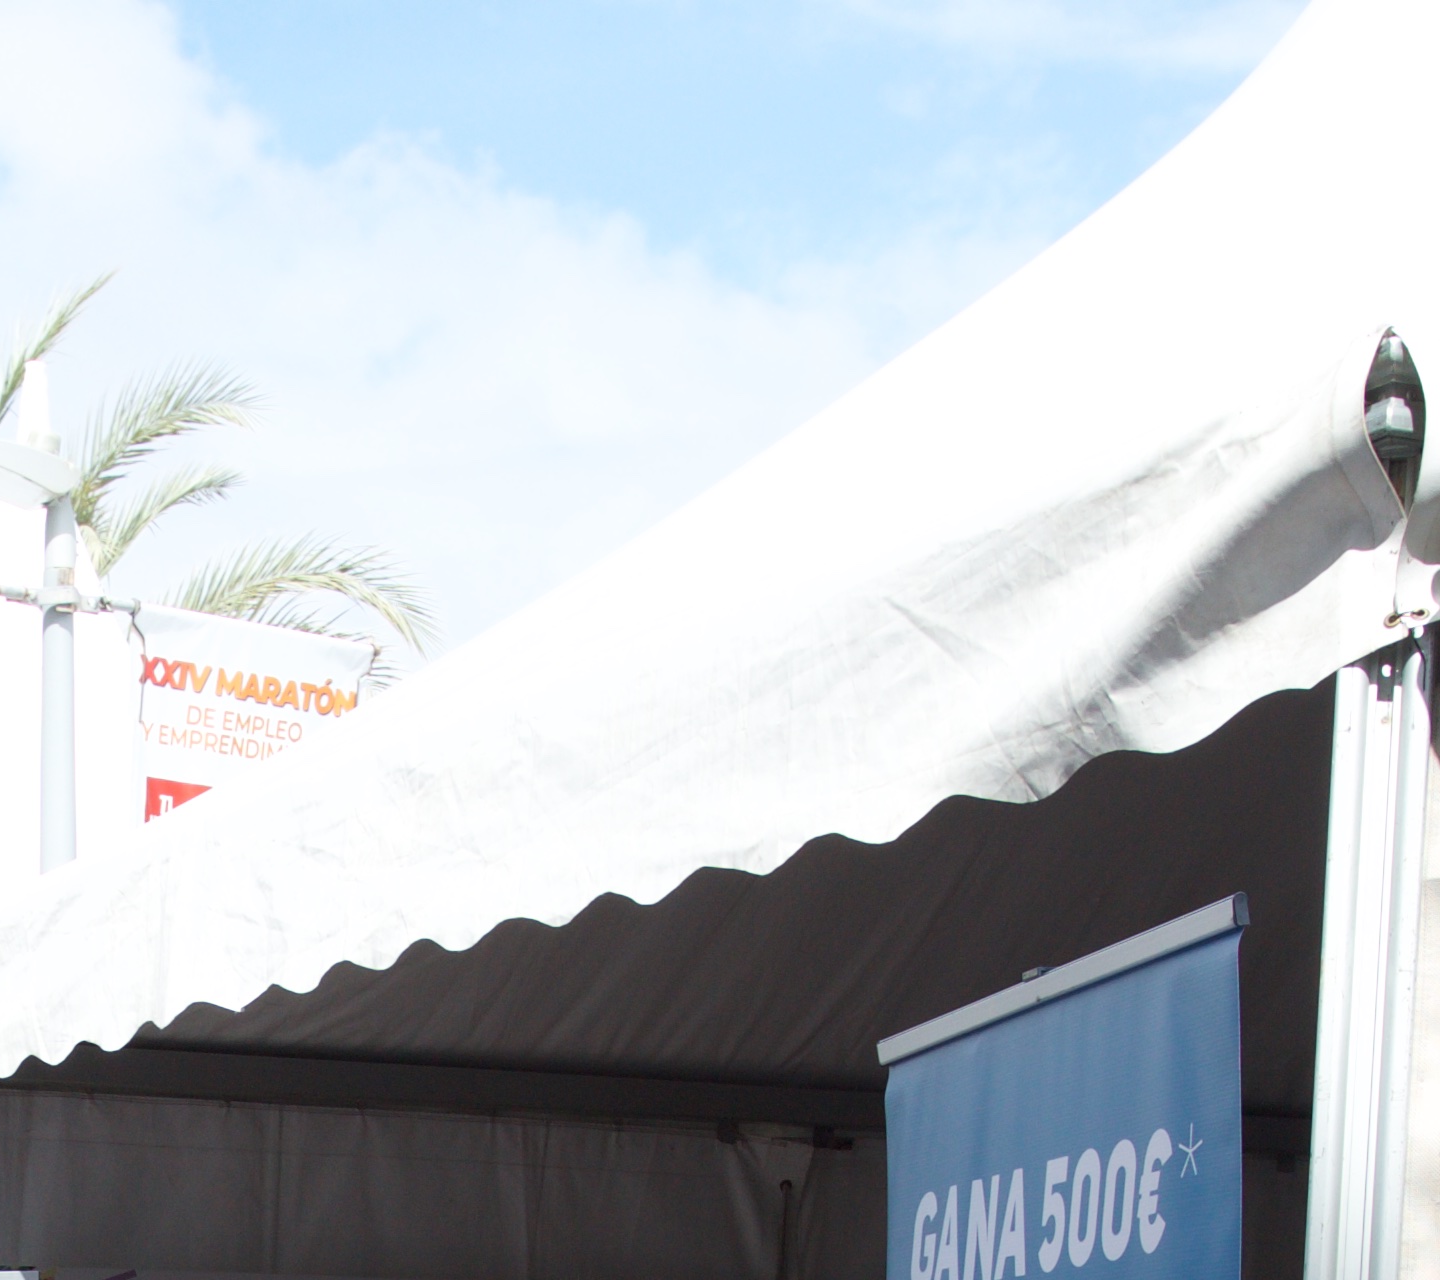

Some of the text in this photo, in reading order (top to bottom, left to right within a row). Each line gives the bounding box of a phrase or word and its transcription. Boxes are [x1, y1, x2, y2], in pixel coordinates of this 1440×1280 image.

[139, 654, 358, 717] XXIV MARATÓN
[186, 705, 302, 743] DE EMPLEO
